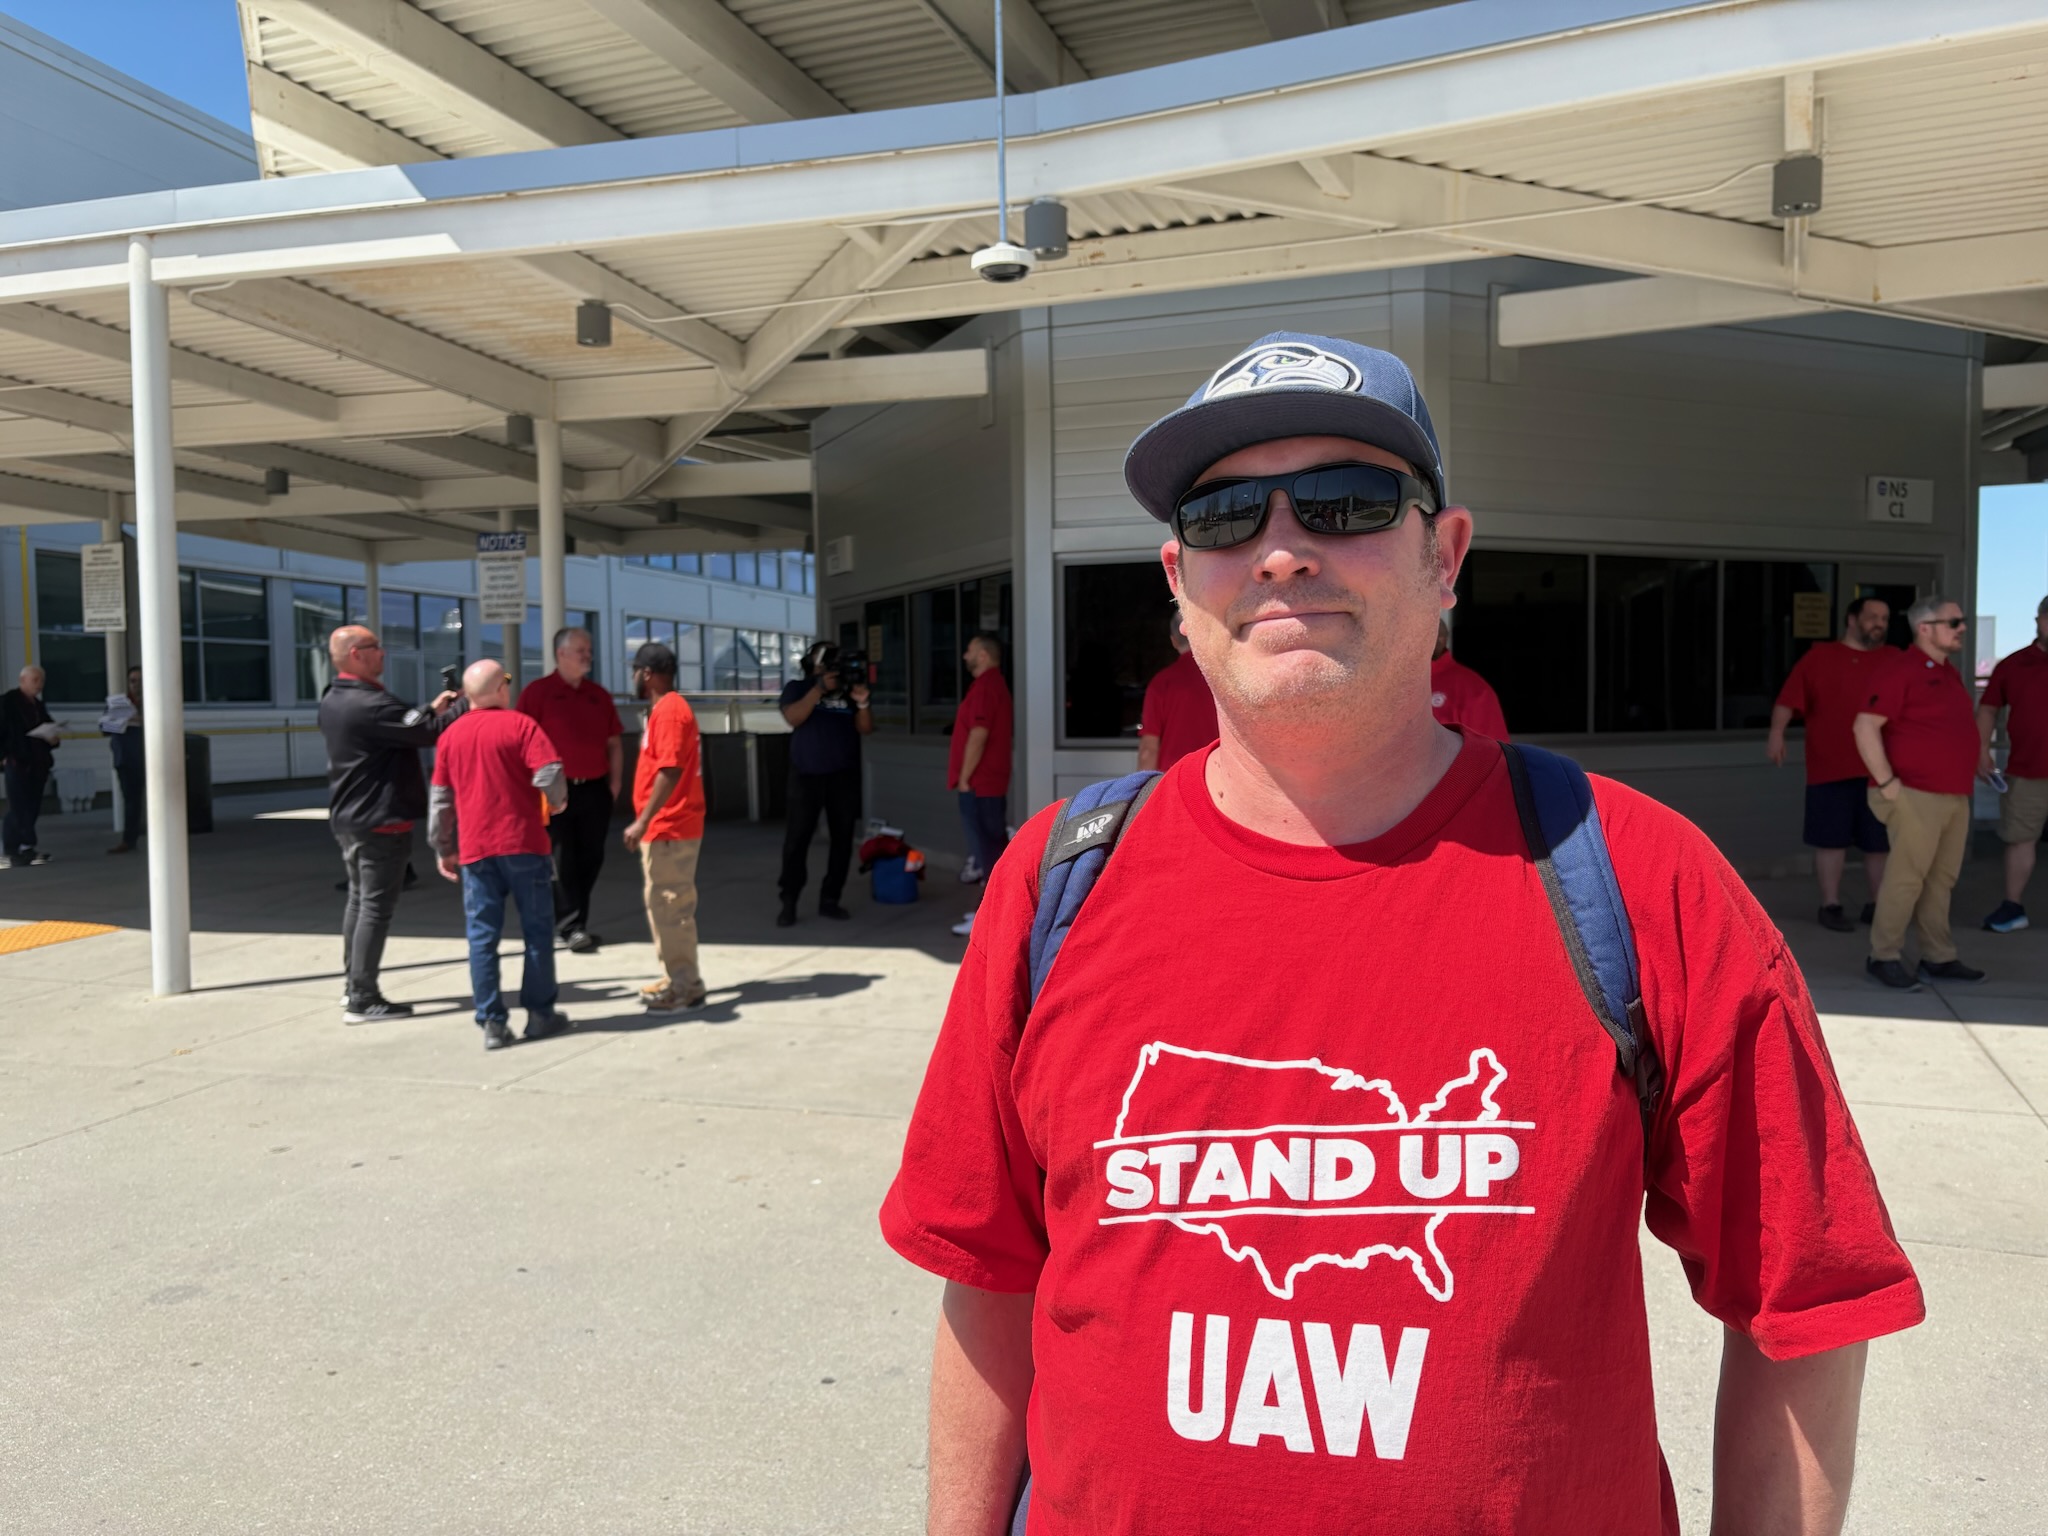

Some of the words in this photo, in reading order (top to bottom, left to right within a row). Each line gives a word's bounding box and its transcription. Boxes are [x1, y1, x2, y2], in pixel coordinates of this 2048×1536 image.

[1889, 481, 1908, 498] N5
[480, 533, 525, 550] NOTICE
[1105, 1137, 1376, 1210] STAND
[1398, 1133, 1520, 1200] UP
[1166, 1310, 1431, 1461] UAW
